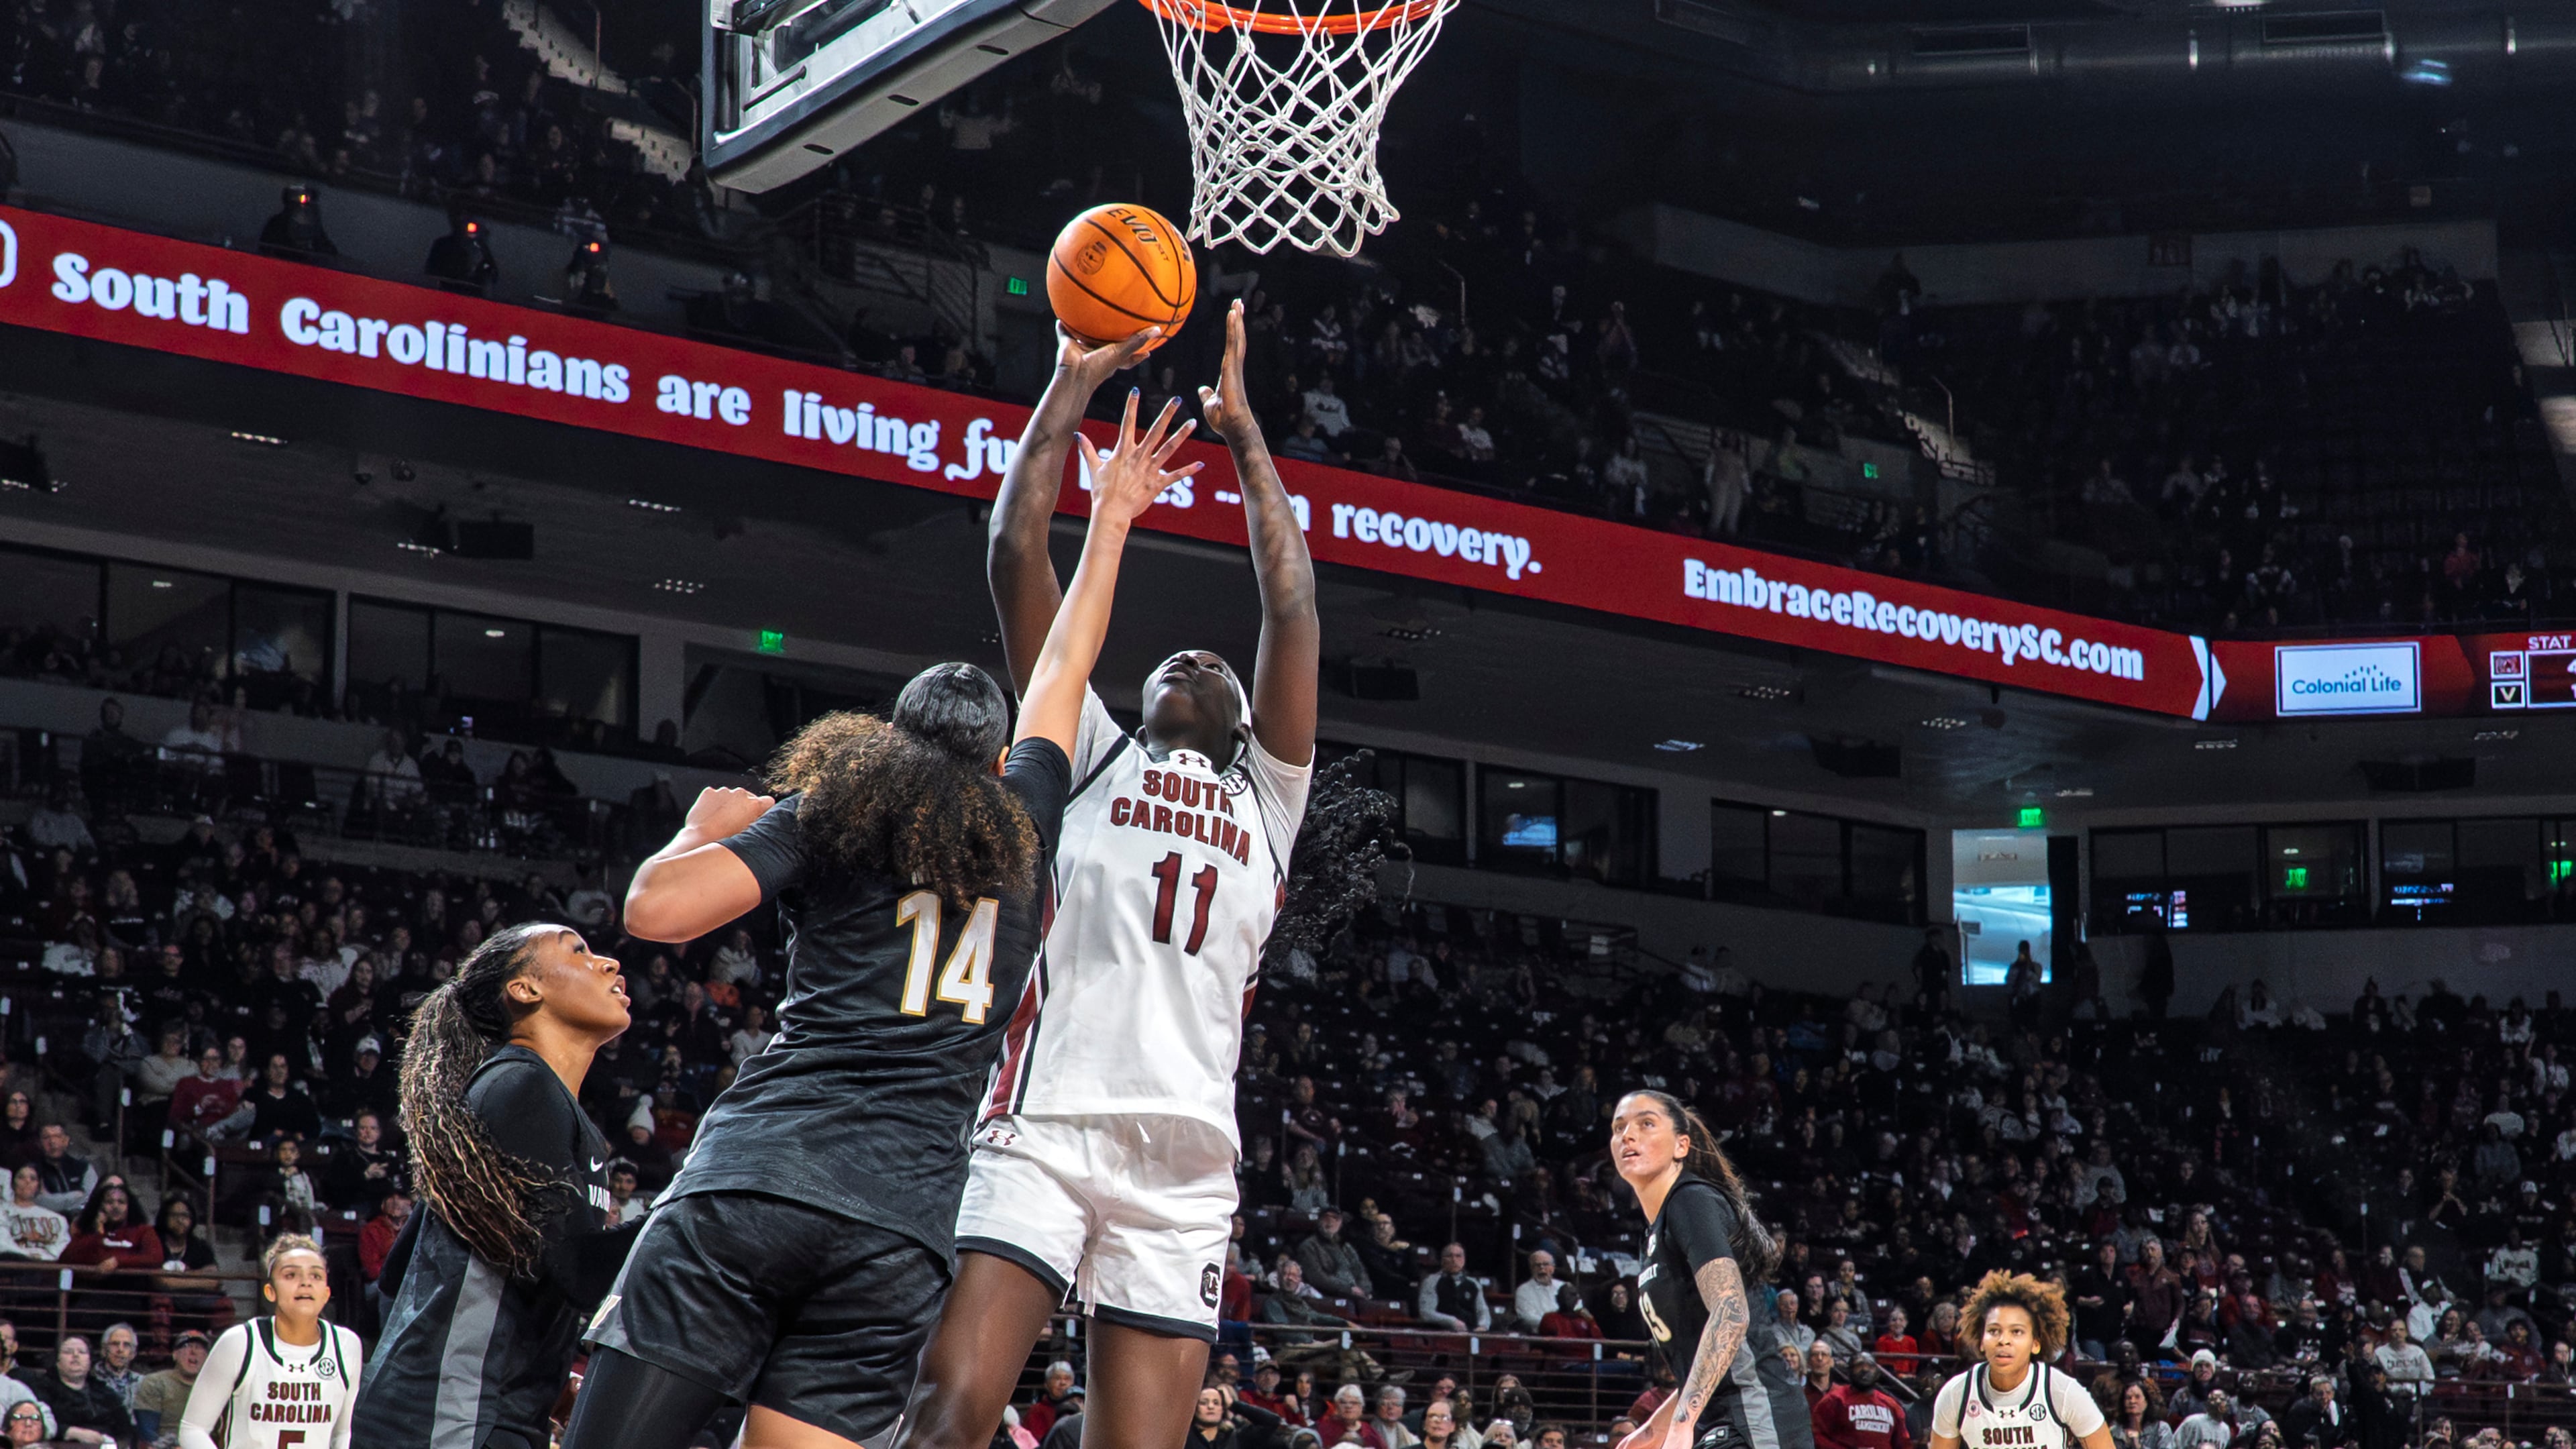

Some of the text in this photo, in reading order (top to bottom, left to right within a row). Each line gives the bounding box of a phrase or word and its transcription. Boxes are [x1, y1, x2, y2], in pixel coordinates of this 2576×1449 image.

[51, 252, 249, 334] South
[280, 297, 630, 403] Carolinians
[655, 374, 751, 426] are
[783, 389, 941, 472] living
[1331, 502, 1542, 580] recovery.
[1683, 558, 2144, 681] EmbraceRecoverySC.com
[2528, 635, 2572, 650] STAT
[2292, 676, 2402, 694] Colonial Life
[2500, 686, 2516, 702] V
[1142, 769, 1234, 819] SOUTH
[1220, 773, 1248, 796] SEC
[1110, 796, 1251, 867] CAROLINA
[1151, 850, 1218, 957] 11
[896, 889, 1000, 1025] 14
[267, 1381, 321, 1401] SOUTH
[250, 1402, 331, 1423] CAROLINA
[1849, 1404, 1894, 1427] CAROLINA
[1982, 1426, 2034, 1444] SOUTH
